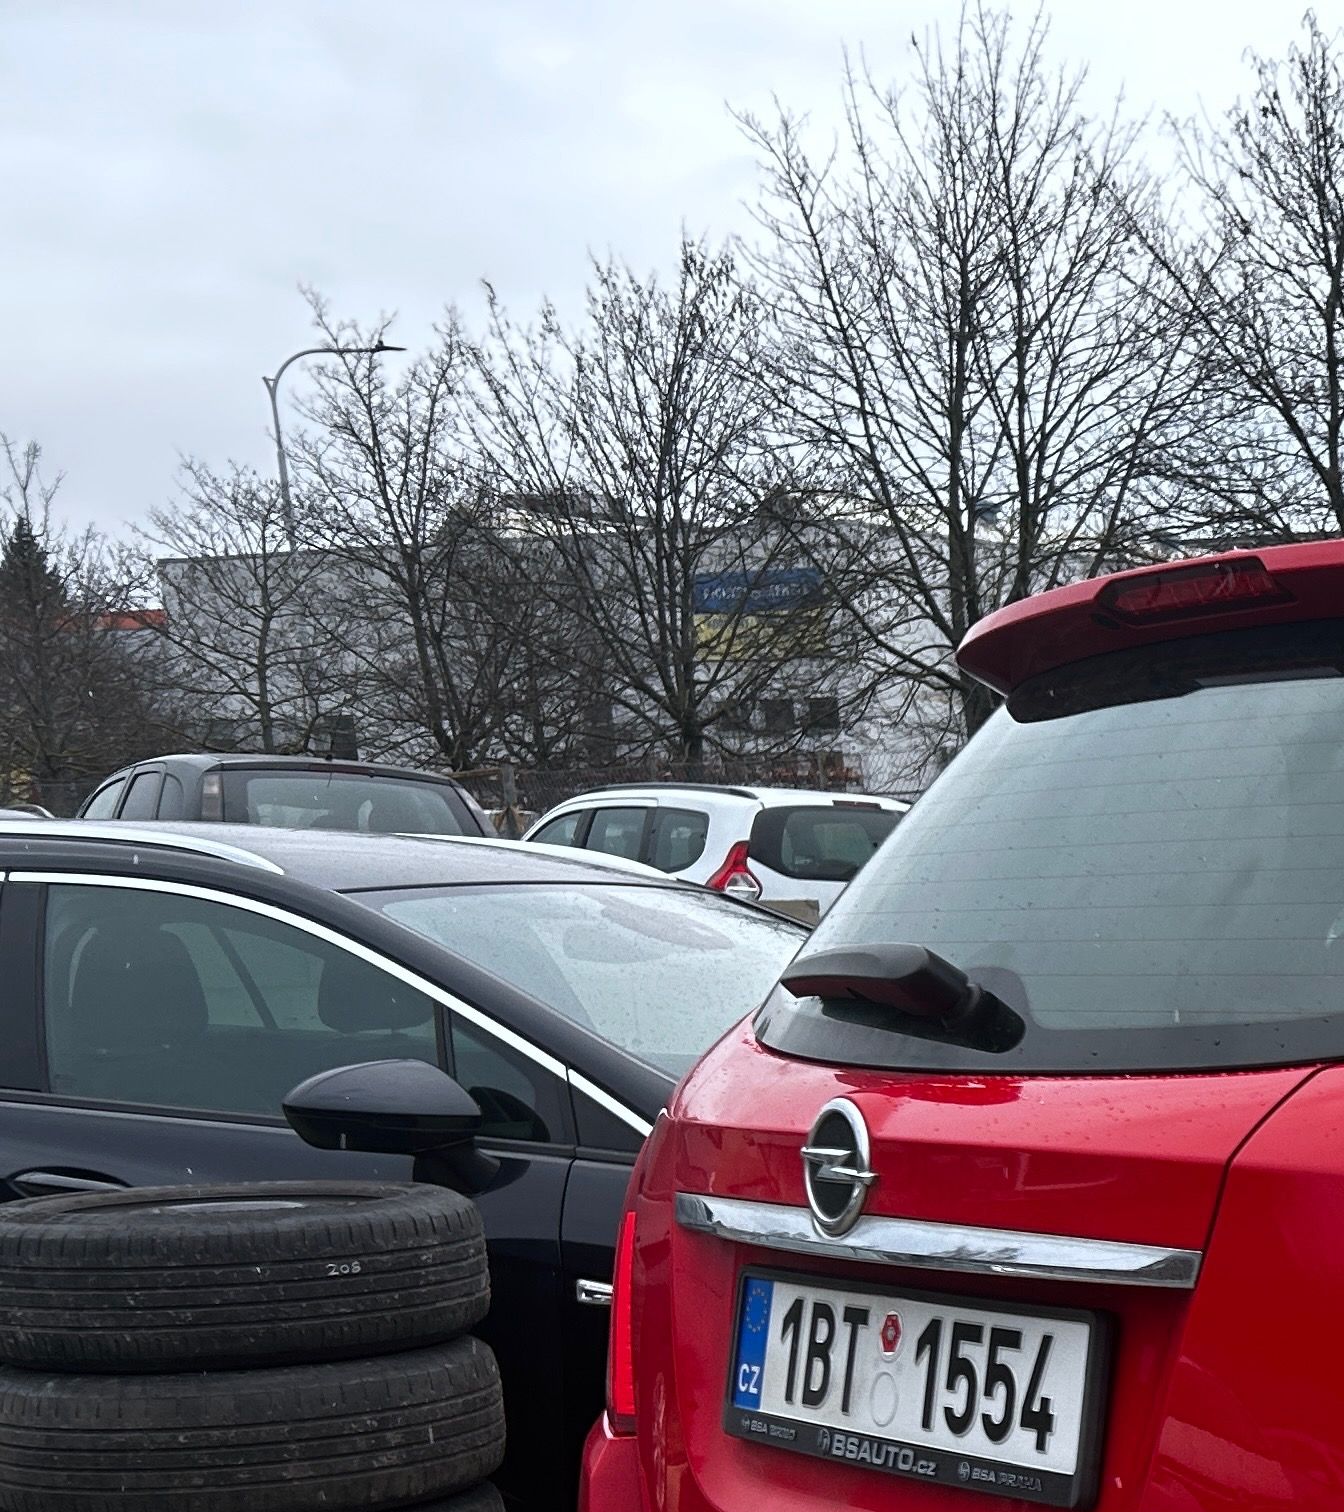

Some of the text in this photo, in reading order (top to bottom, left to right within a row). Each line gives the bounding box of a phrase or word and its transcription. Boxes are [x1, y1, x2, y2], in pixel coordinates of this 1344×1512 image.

[325, 1260, 362, 1277] 208
[738, 1362, 759, 1395] CZ
[781, 1298, 1054, 1453] 1BT 1554
